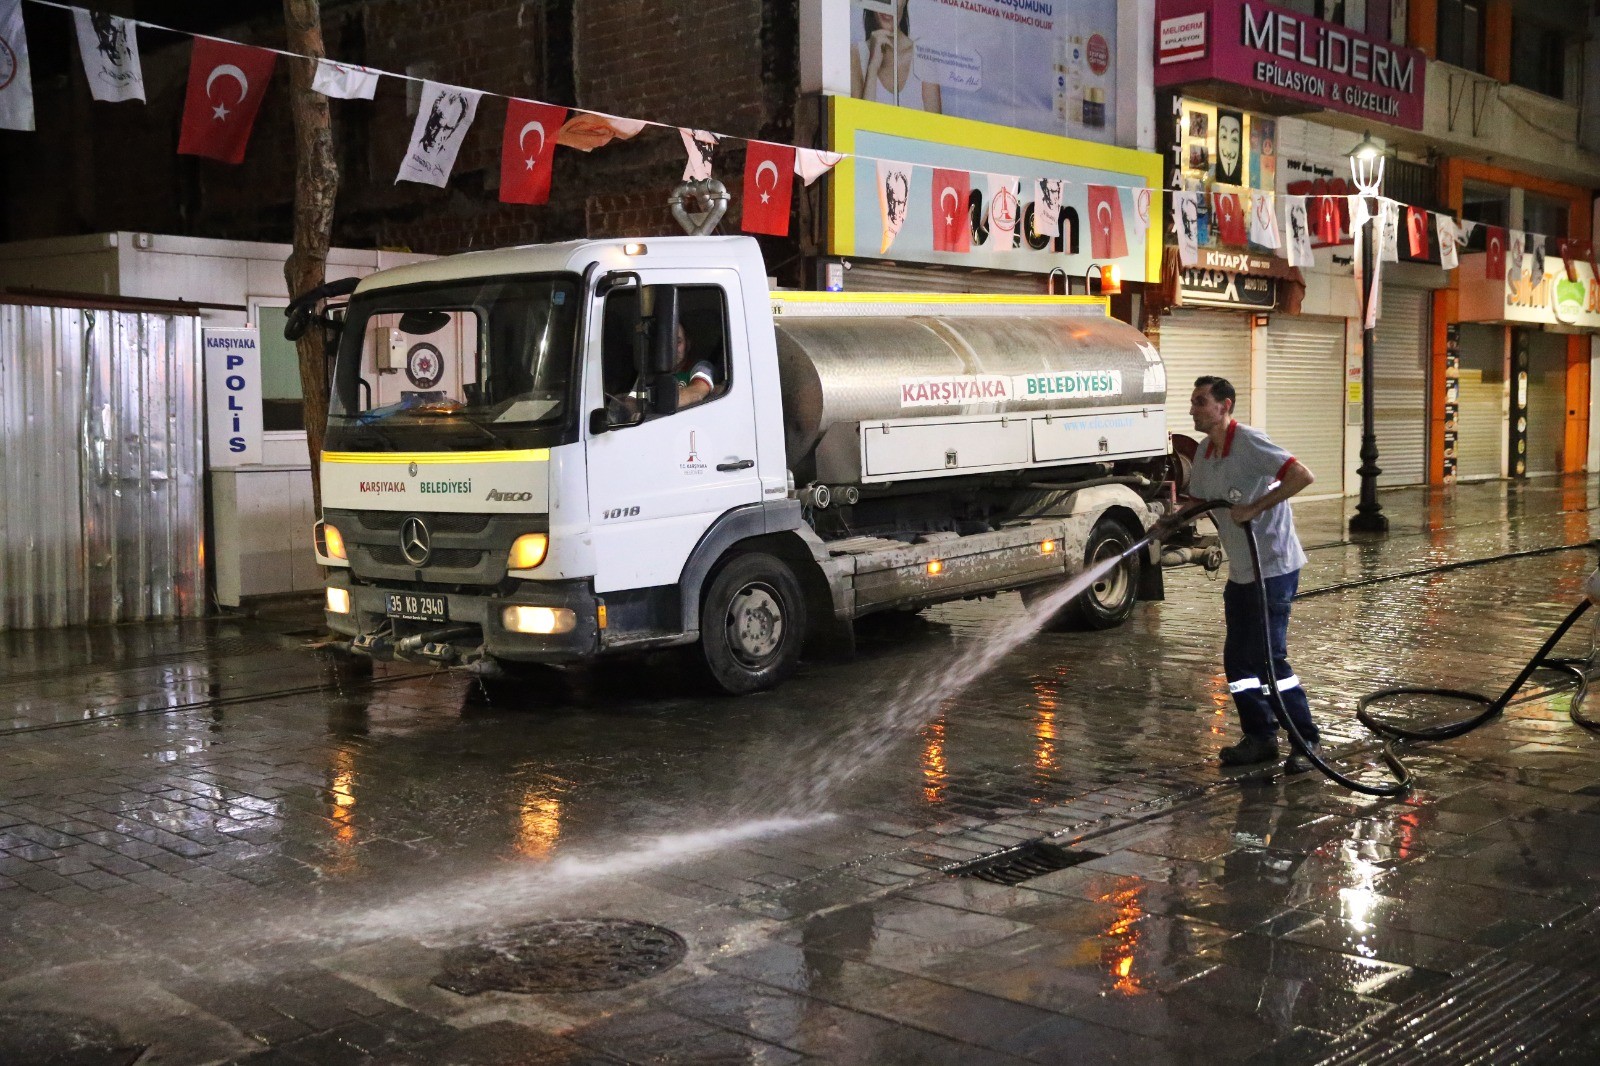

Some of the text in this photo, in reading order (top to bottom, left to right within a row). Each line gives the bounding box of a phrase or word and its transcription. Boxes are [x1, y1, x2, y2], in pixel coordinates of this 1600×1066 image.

[960, 2, 1000, 17] AZALTMAYA
[1001, 10, 1034, 26] YARDIMCI
[994, 0, 1053, 16] UŞUMUNU
[1257, 61, 1399, 117] EPİLASYON & GÜZELLİK
[207, 337, 256, 351] KARŞIYAKA
[902, 371, 1113, 404] KARŞIYAKA BELEDİYESİ
[225, 355, 247, 453] POLİS
[360, 478, 472, 495] KARŞIYAKA BELEDİYESİ
[603, 506, 640, 519] 1018
[391, 595, 444, 615] 35 KB 2940
